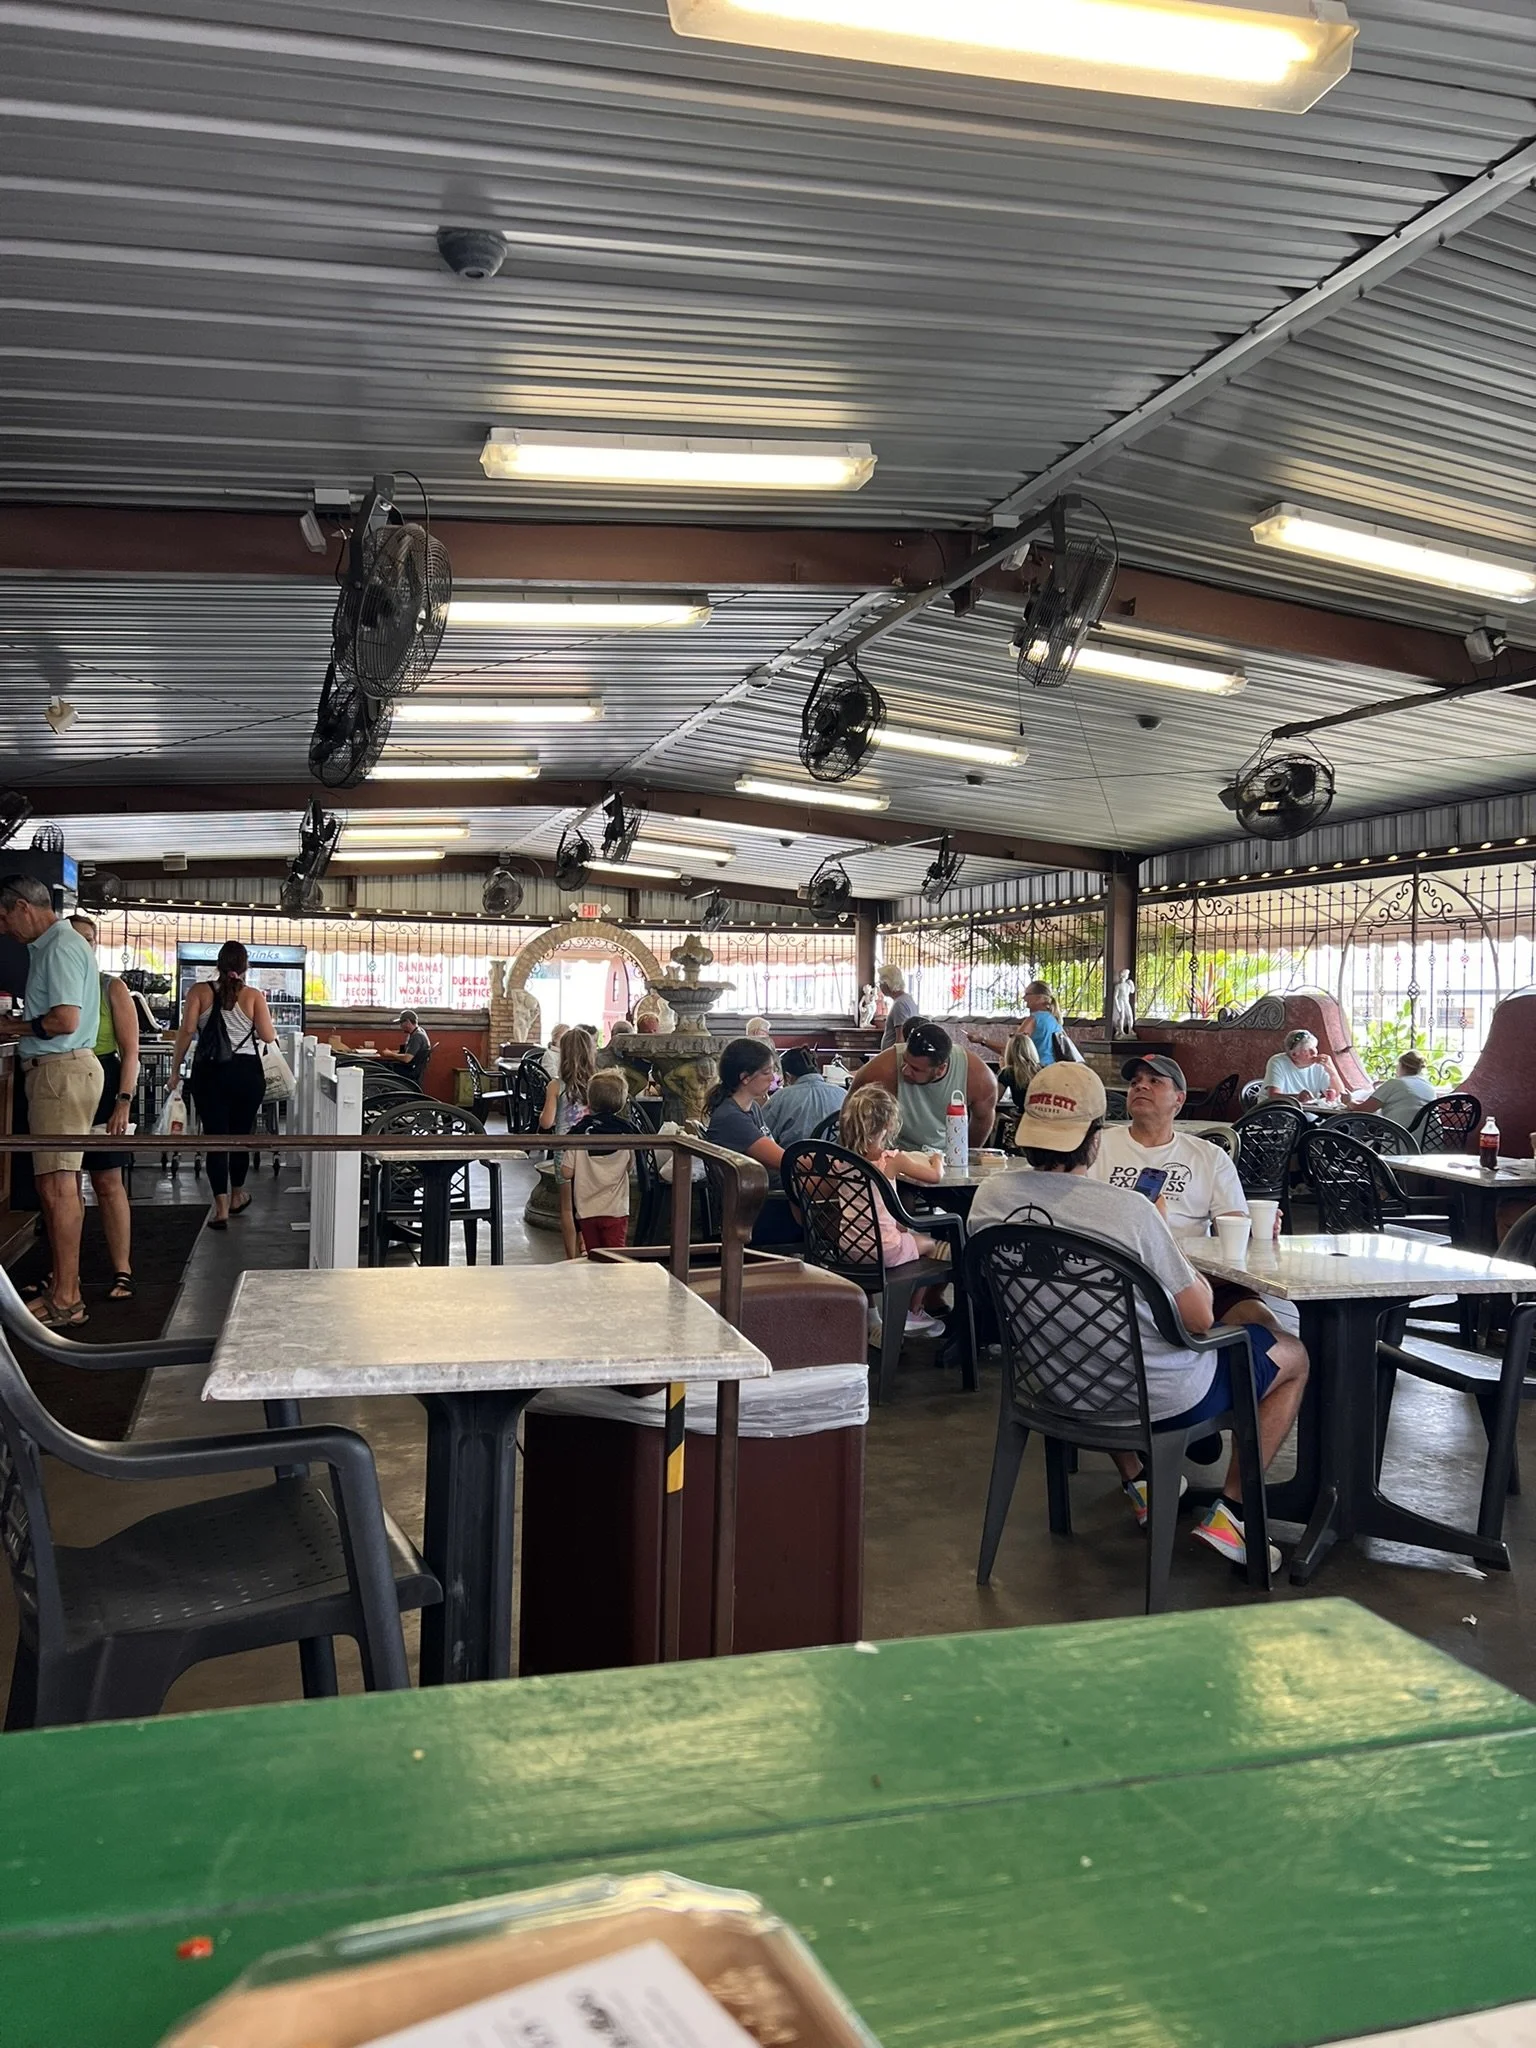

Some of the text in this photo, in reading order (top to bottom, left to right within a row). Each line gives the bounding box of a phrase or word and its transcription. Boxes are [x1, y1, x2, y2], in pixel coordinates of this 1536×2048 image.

[582, 904, 598, 916] EXIT
[398, 961, 443, 974] BANANAS
[407, 974, 433, 984] MUSIC
[345, 987, 378, 997] RECORD
[458, 988, 490, 998] SERVICE
[1053, 1094, 1077, 1112] CITY
